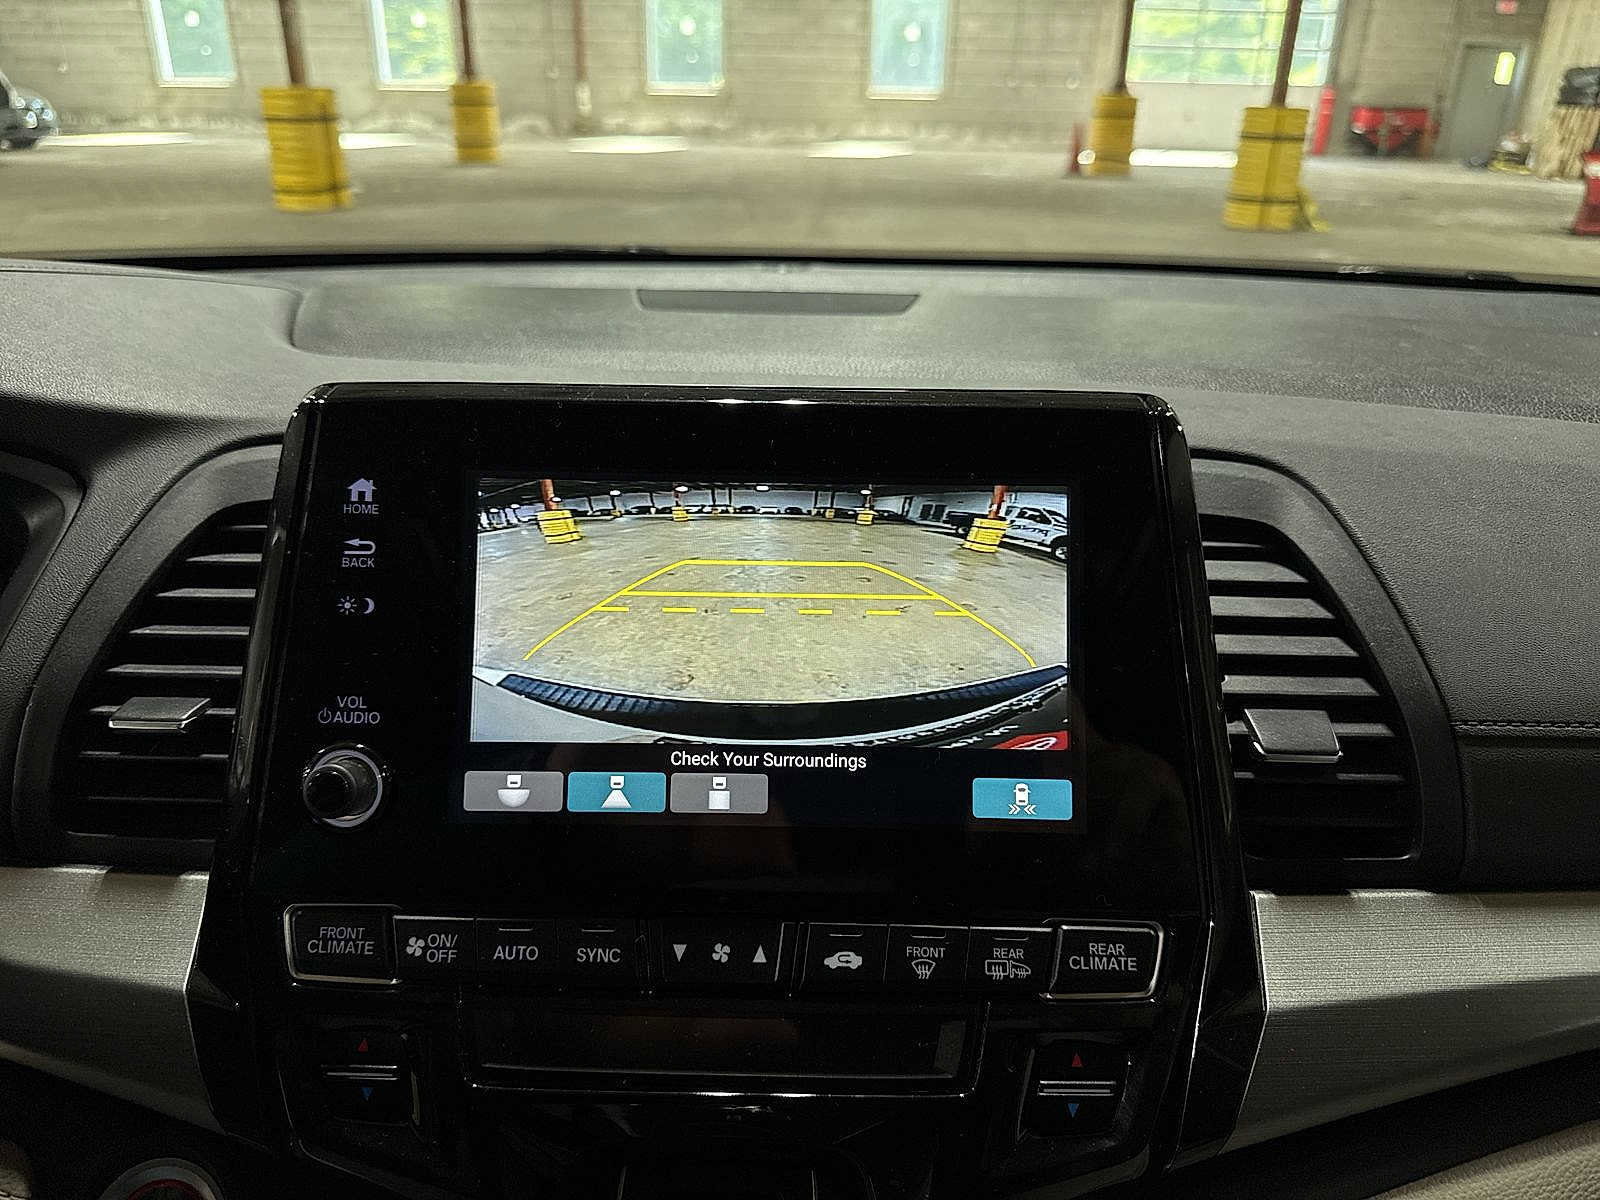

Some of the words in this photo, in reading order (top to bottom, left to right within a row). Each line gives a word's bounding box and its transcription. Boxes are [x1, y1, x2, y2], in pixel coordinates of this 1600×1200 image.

[343, 504, 379, 515] HOME
[342, 557, 375, 568] BACK
[337, 696, 367, 708] VOL
[333, 711, 380, 725] AUDIO
[670, 751, 719, 767] Check
[723, 751, 759, 767] Your
[763, 752, 867, 772] Surroundings
[319, 926, 366, 940] FRONT
[307, 939, 375, 955] CLIMATE
[428, 933, 458, 948] ON/
[426, 949, 458, 963] OFF
[493, 945, 539, 961] AUTO
[576, 948, 621, 963] SYNC
[906, 946, 946, 959] FRONT
[993, 948, 1024, 960] REAR
[1089, 943, 1125, 956] REAR
[1069, 955, 1137, 971] CLIMATE
